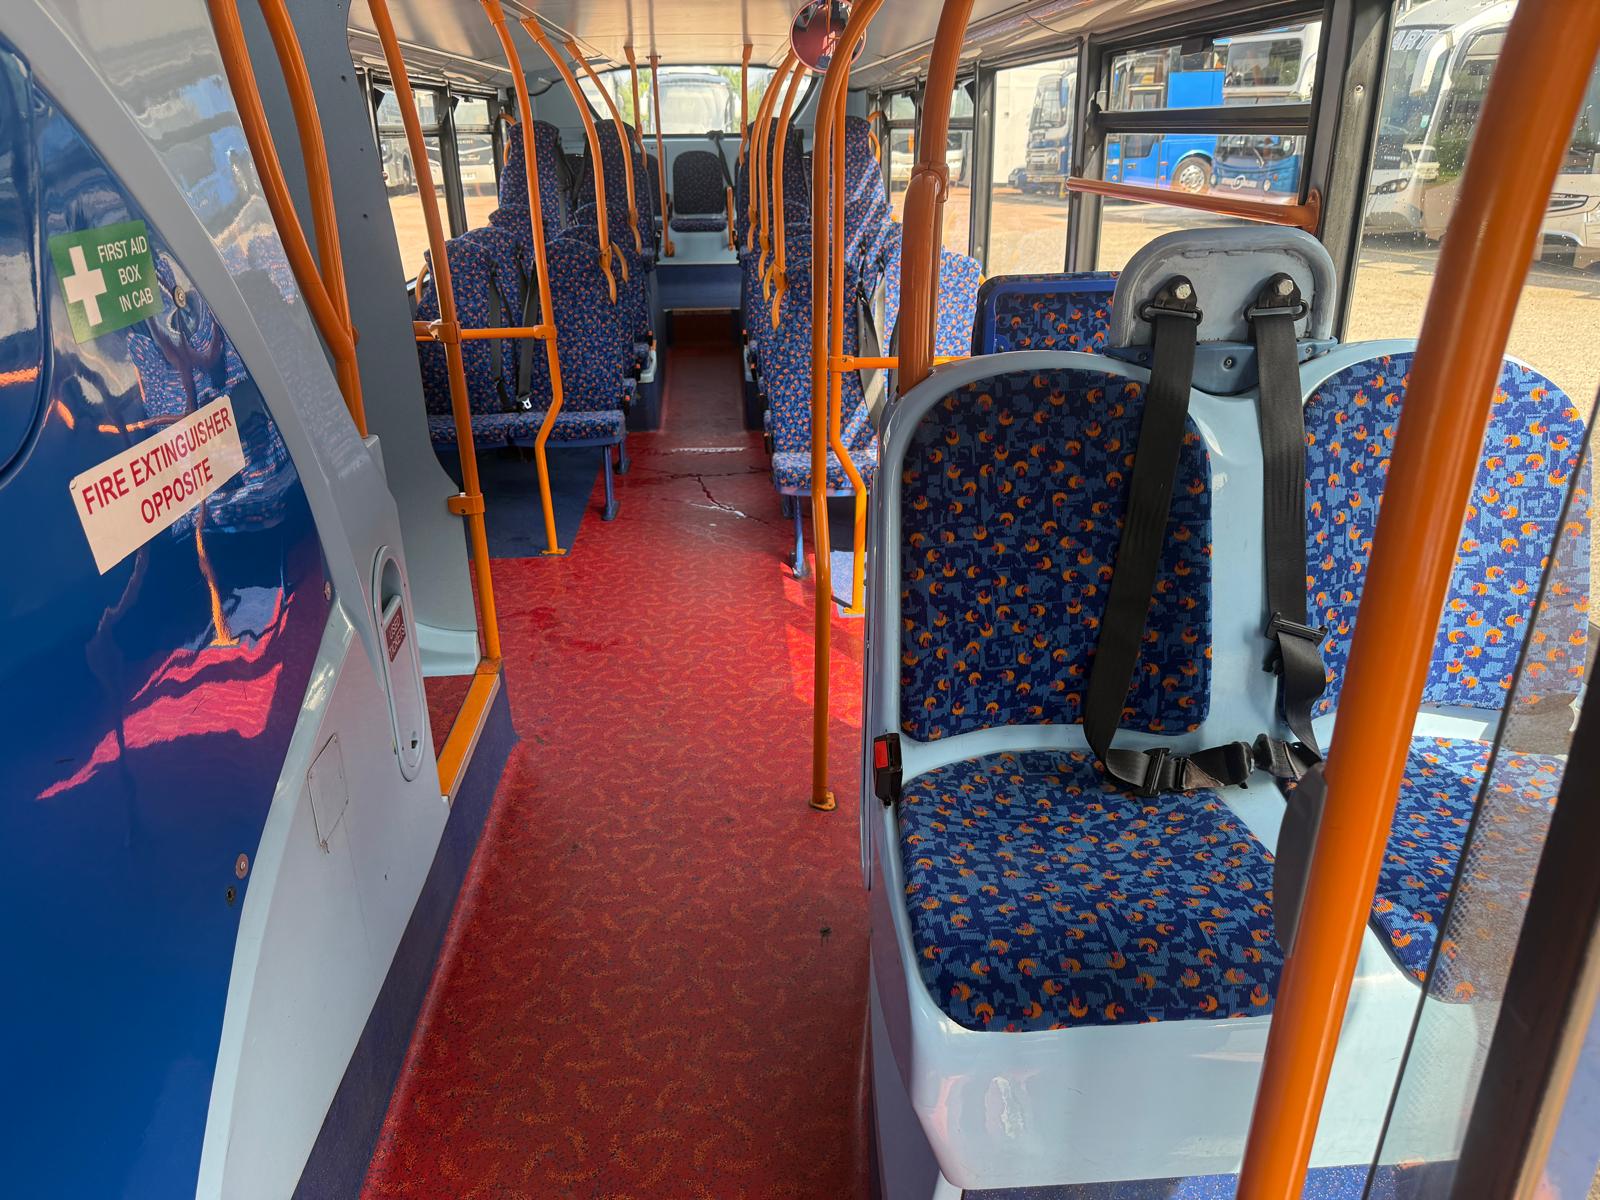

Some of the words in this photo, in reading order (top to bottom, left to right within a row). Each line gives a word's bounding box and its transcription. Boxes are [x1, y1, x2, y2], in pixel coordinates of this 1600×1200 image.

[97, 240, 127, 263] FIRST
[130, 236, 148, 255] AID
[118, 264, 142, 285] BOX
[119, 294, 132, 313] IN
[132, 287, 154, 308] CAB
[82, 468, 130, 515] FIRE
[129, 407, 232, 487] EXTINGUISHER
[140, 457, 213, 524] OPPOSITE
[389, 623, 405, 659] TICKETS
[390, 615, 402, 640] USED
